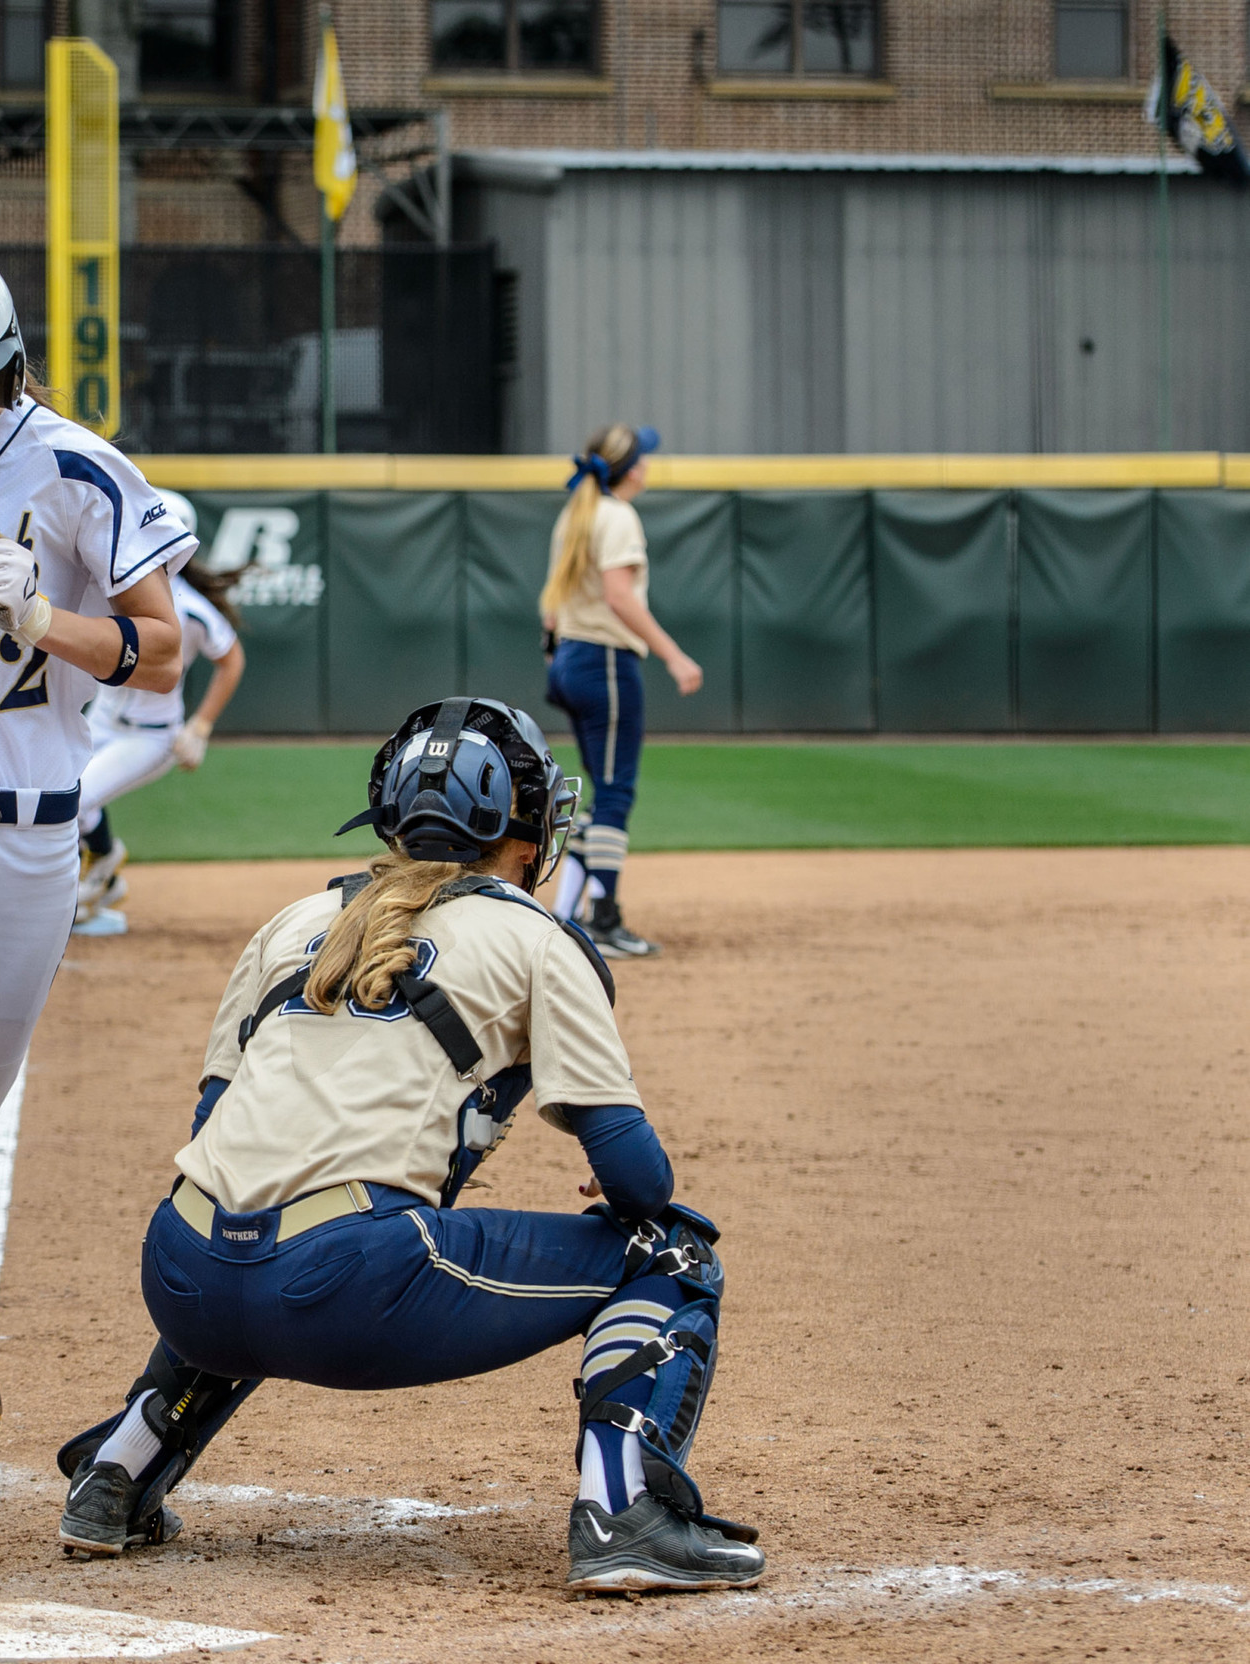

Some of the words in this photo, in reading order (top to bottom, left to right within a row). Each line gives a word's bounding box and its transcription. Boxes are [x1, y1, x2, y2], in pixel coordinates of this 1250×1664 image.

[77, 257, 109, 421] 190
[140, 502, 167, 529] ACC
[208, 507, 300, 574] R
